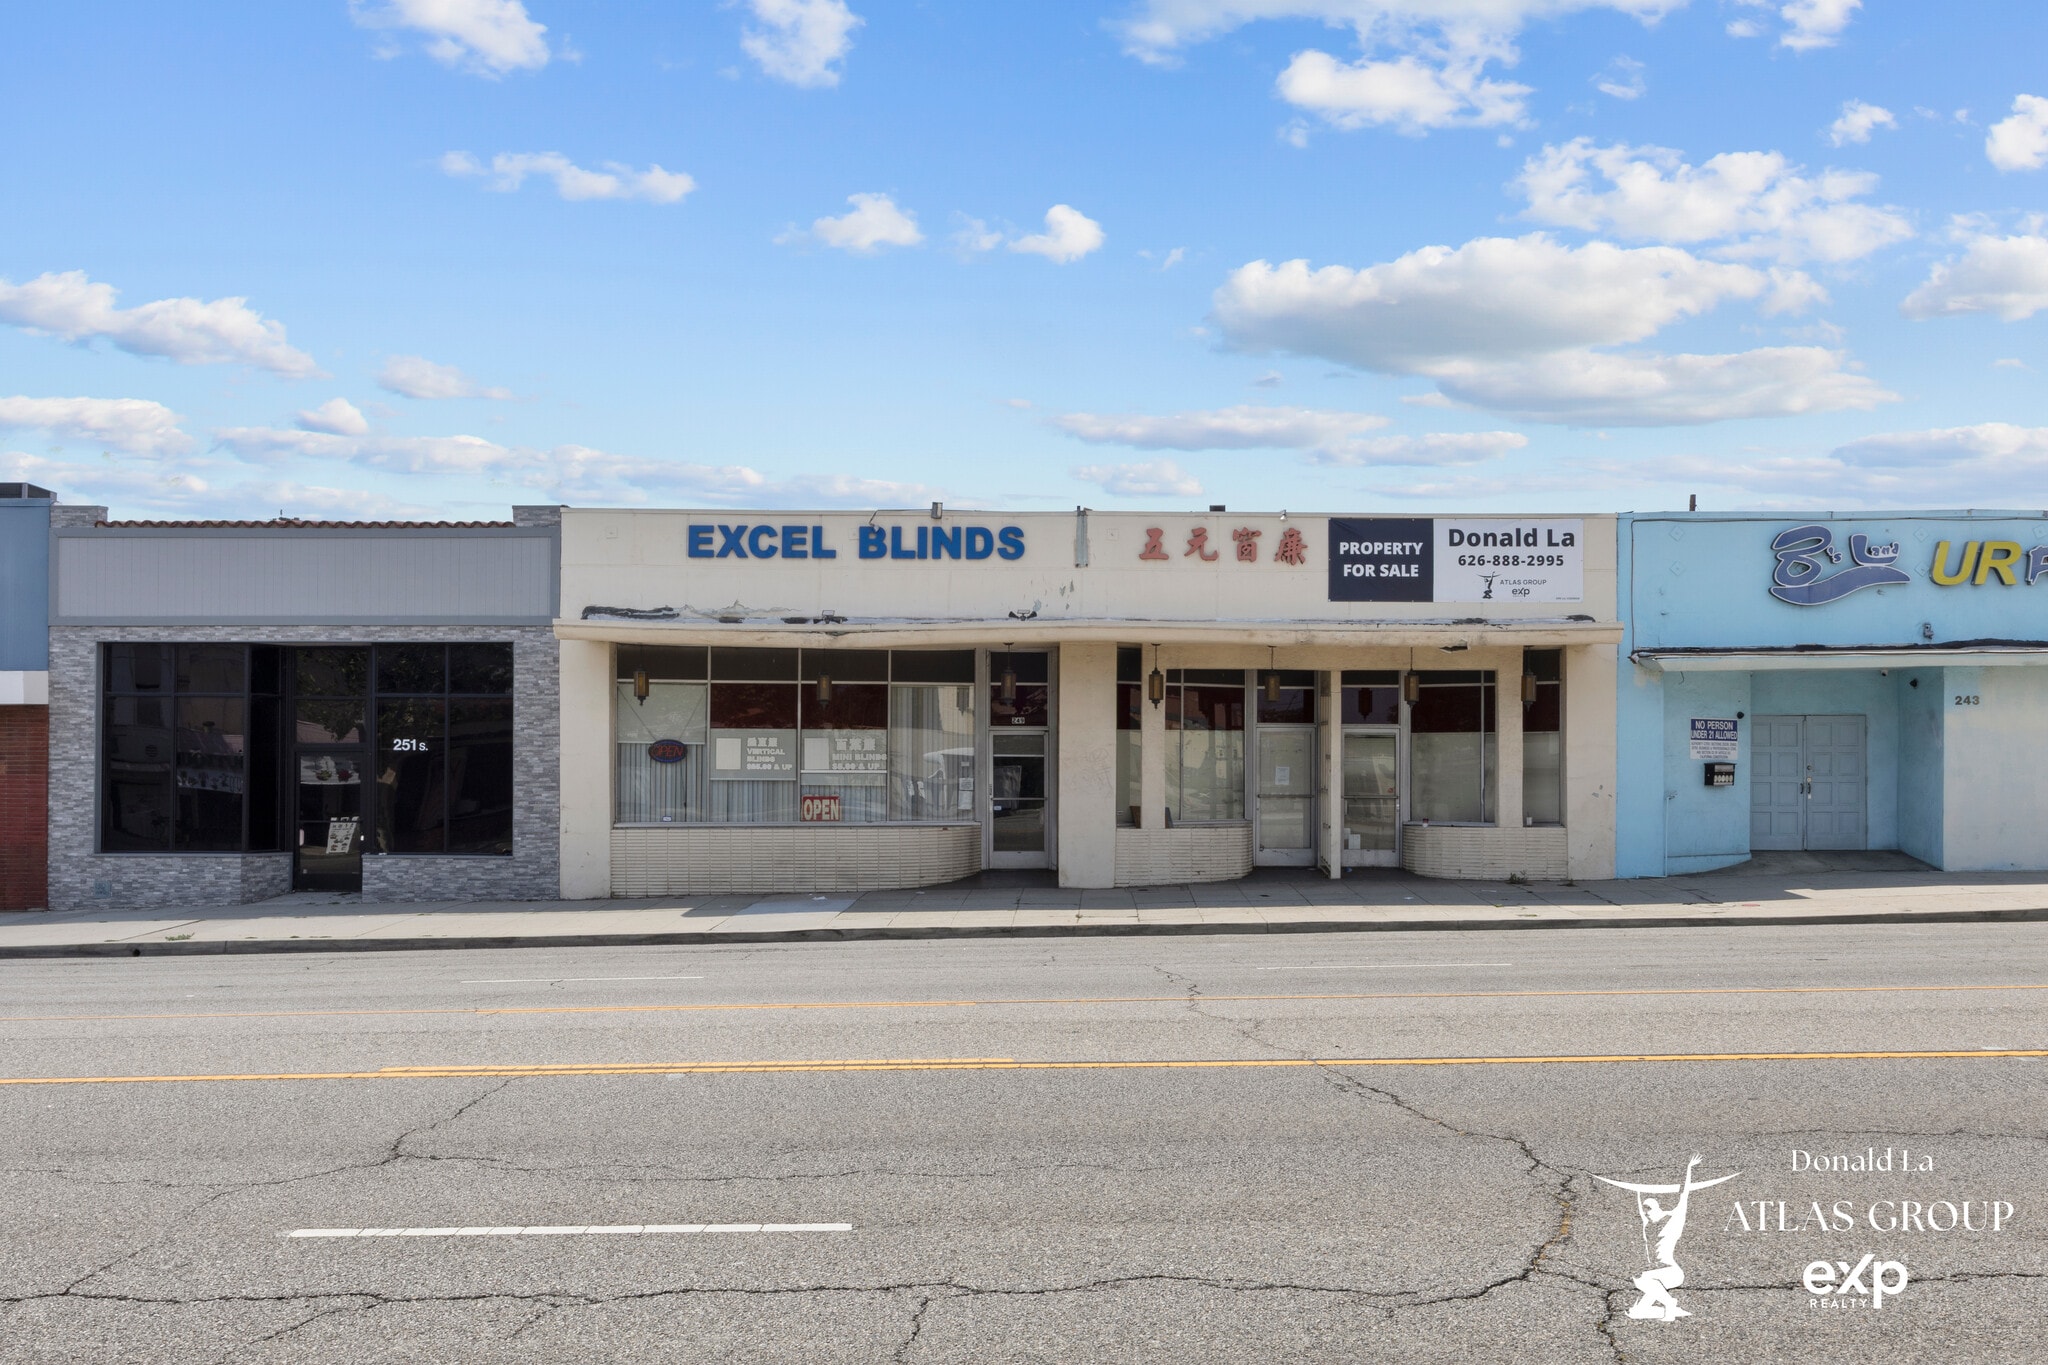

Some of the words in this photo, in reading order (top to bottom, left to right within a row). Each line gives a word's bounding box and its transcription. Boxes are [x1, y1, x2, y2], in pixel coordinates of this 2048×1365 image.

[688, 525, 837, 559] EXCEL
[859, 525, 1025, 560] BLINDS
[1449, 528, 1537, 547] Donald
[1547, 529, 1575, 547] La
[1340, 542, 1423, 555] PROPERTY
[1458, 555, 1564, 566] 626-888-2995
[1343, 564, 1376, 577] FOR
[1379, 564, 1419, 577] SALE
[1955, 695, 1980, 705] 243
[1695, 720, 1705, 729] NO
[1707, 721, 1733, 730] PERSON
[1691, 730, 1707, 739] UNDER
[1709, 730, 1714, 739] 21
[1715, 730, 1737, 739] ALLOWED
[393, 739, 417, 751] 251
[651, 745, 684, 757] OPEN
[832, 753, 852, 761] MINI
[854, 753, 887, 761] BLINDS
[868, 762, 880, 770] UP
[803, 799, 839, 820] OPEN
